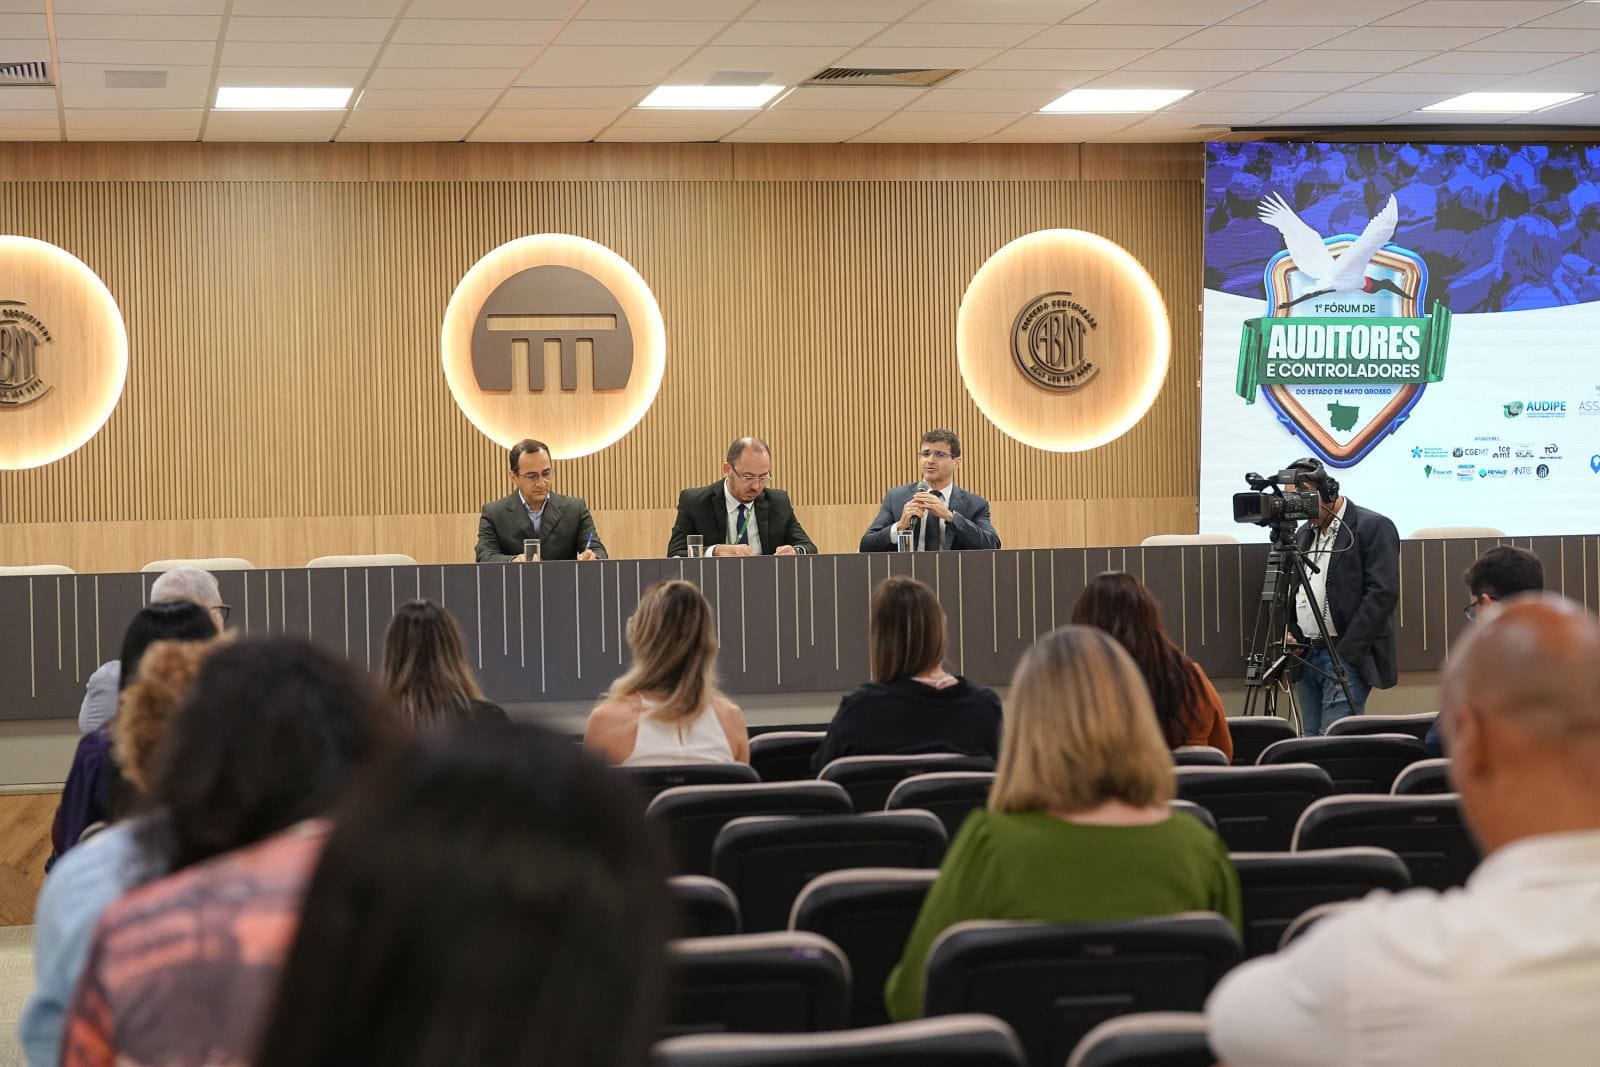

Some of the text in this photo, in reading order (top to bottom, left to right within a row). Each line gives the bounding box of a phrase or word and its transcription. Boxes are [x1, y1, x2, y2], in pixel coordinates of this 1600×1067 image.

[1324, 302, 1360, 313] FÓRUM
[1362, 304, 1376, 313] DE
[1267, 324, 1421, 360] AUDITORES
[1266, 363, 1420, 378] E CONTROLADORES
[1526, 401, 1567, 411] AUDIPE
[1578, 401, 1600, 411] ASS
[1544, 443, 1559, 454] TCU
